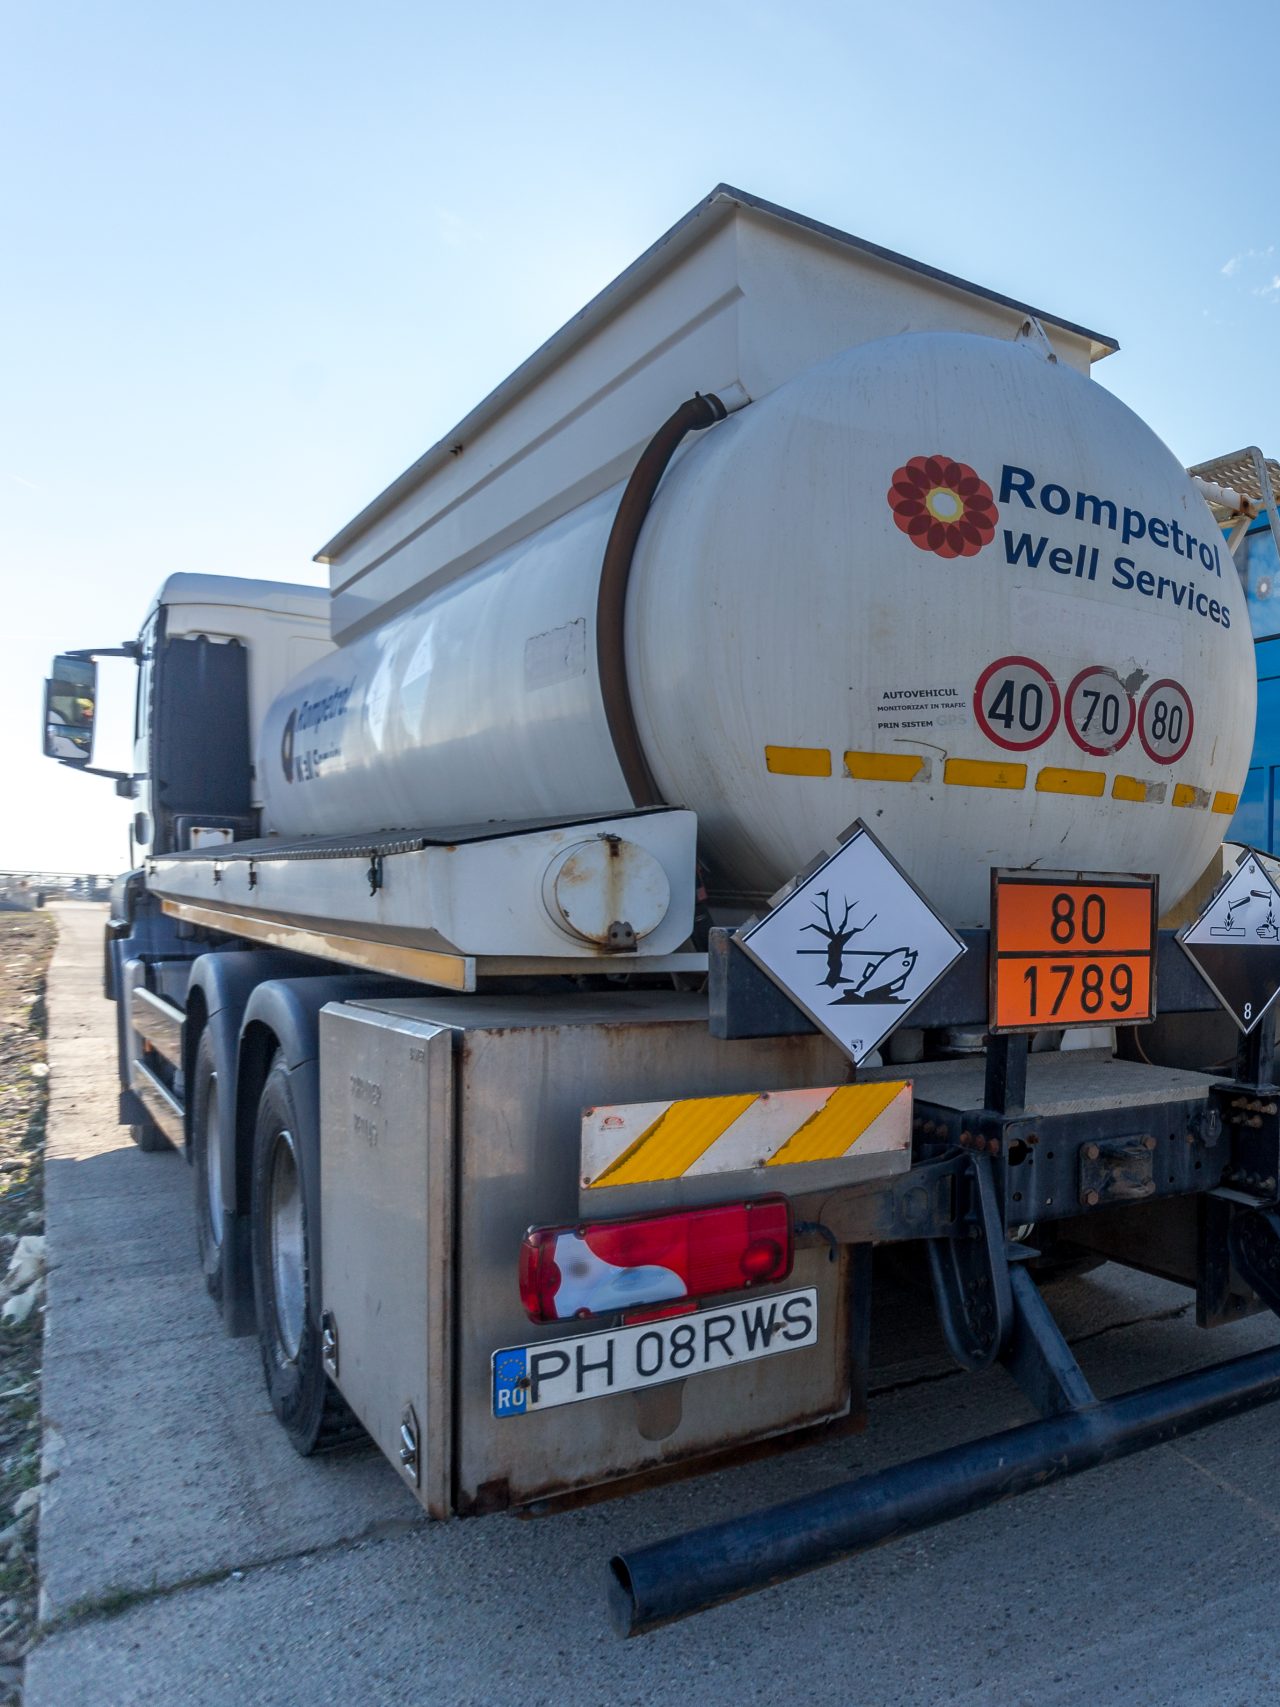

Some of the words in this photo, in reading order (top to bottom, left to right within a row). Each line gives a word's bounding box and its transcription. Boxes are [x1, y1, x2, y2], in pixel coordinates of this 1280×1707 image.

[998, 464, 1222, 578] Rompetrol
[1003, 529, 1100, 581] Well
[1111, 556, 1231, 629] Services
[877, 703, 929, 712] MONITORIZAT
[882, 688, 959, 700] AUTOVEHICUL
[987, 679, 1043, 732] 40
[1081, 689, 1120, 736] 70
[1151, 700, 1183, 744] 80
[1051, 892, 1107, 945] 80
[1023, 962, 1134, 1018] 1789
[1244, 1002, 1252, 1020] 8
[498, 1387, 525, 1409] RO
[530, 1338, 614, 1404] PH
